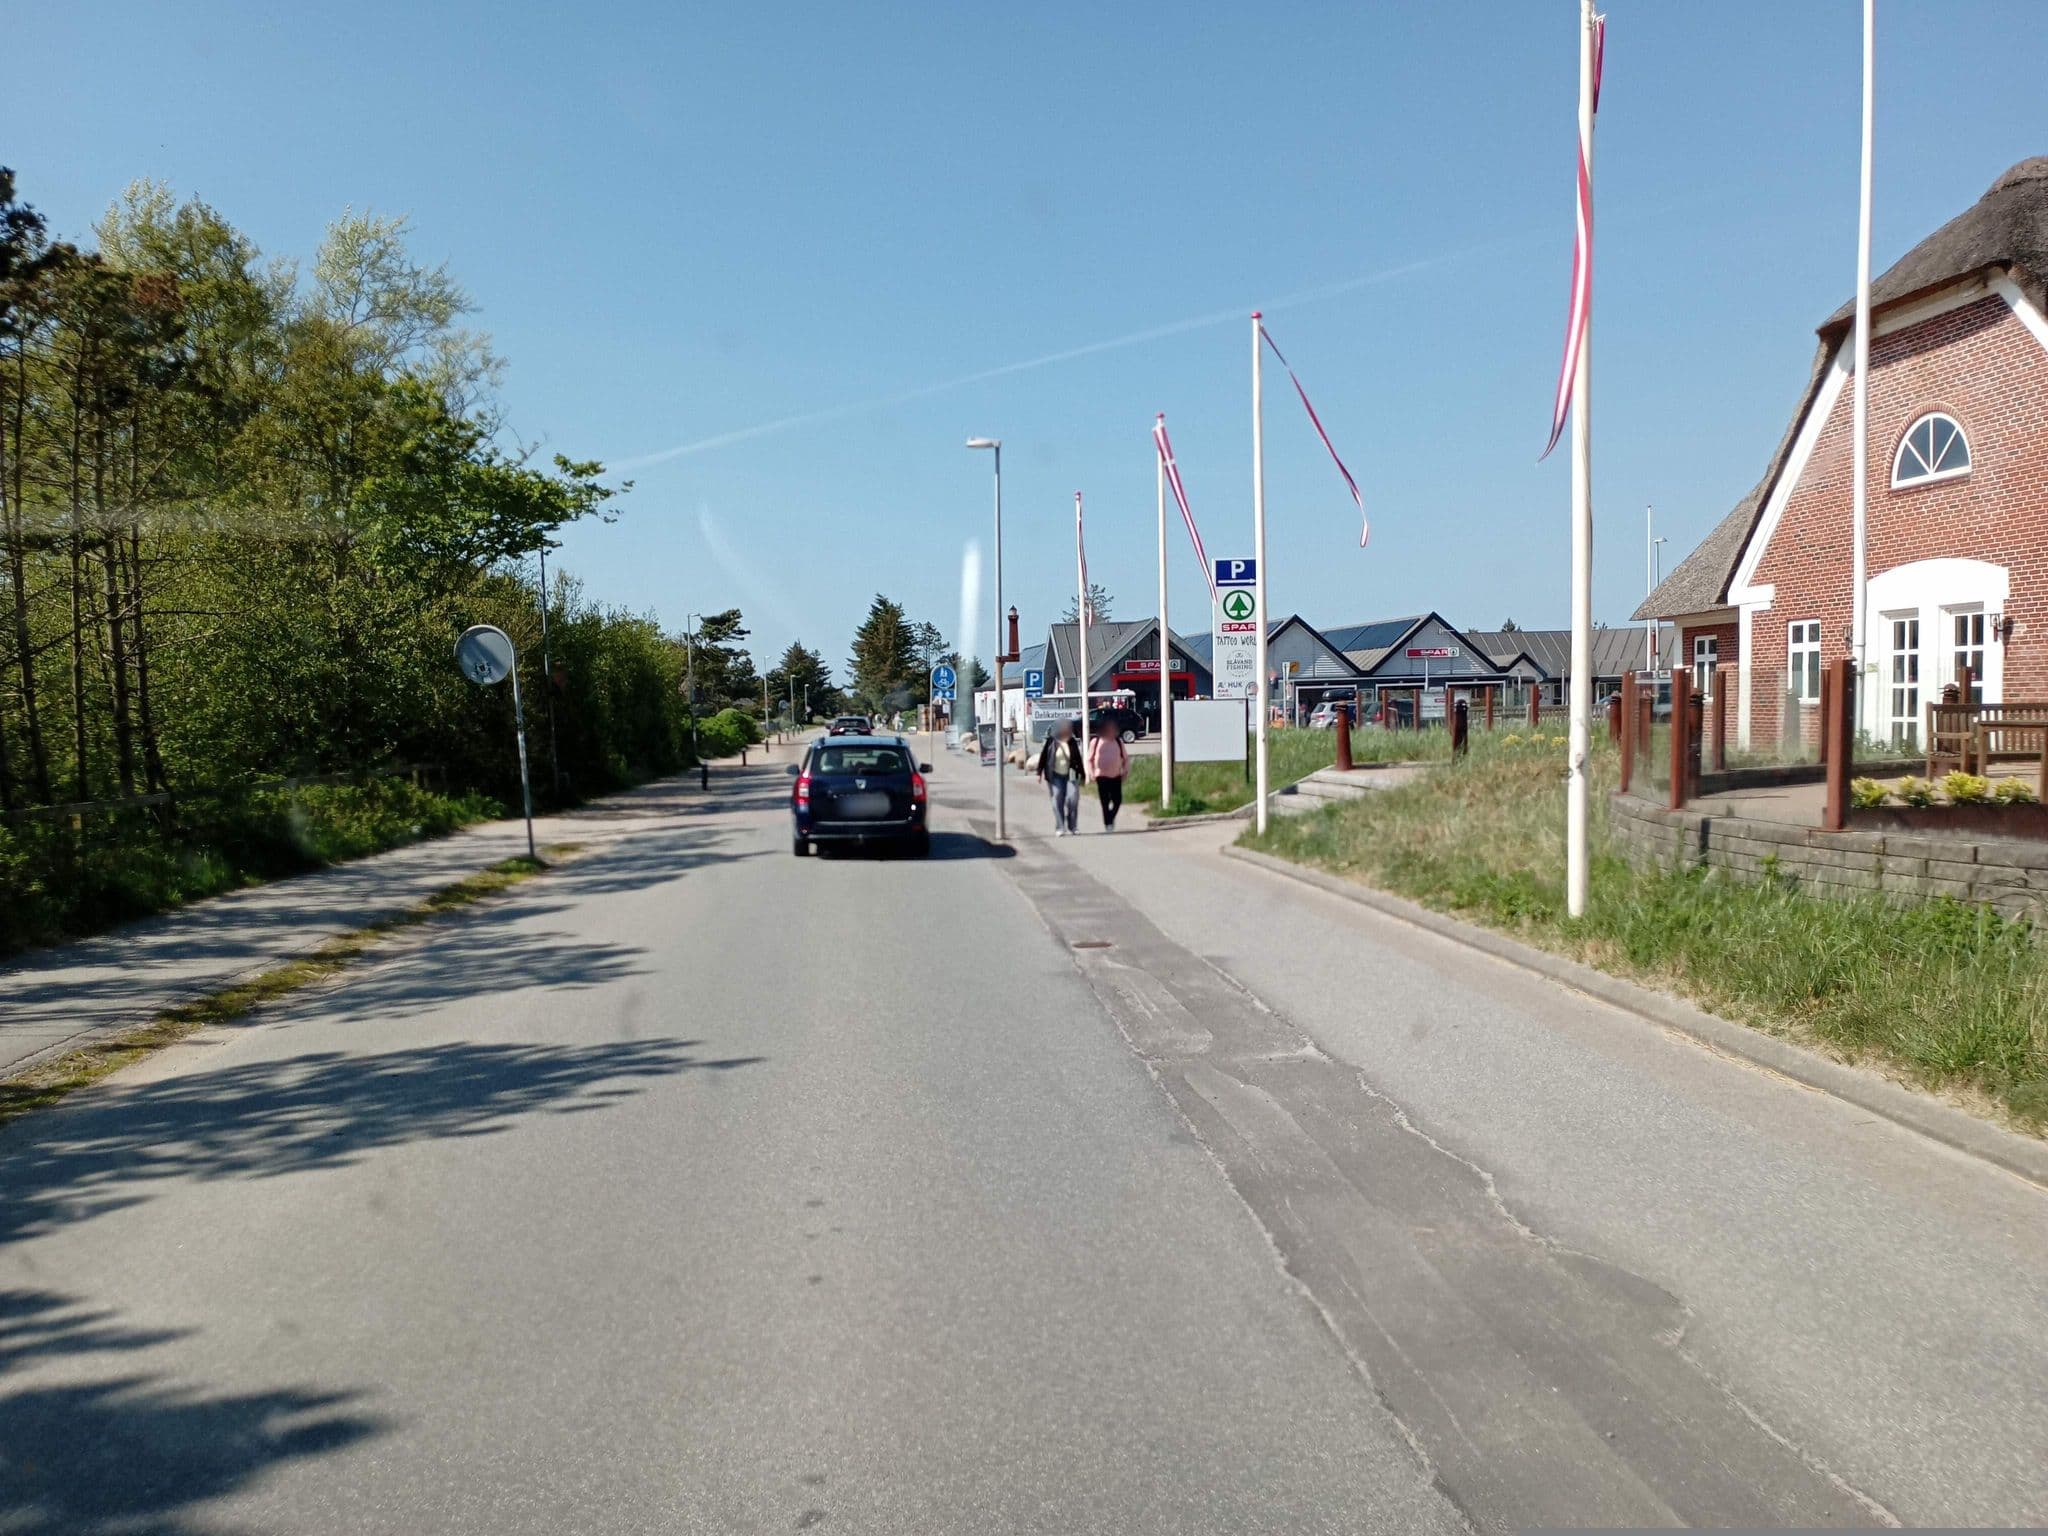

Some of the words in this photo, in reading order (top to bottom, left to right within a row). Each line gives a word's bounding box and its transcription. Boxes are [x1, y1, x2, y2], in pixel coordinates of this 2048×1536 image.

[1230, 560, 1245, 579] P
[1222, 624, 1256, 632] SPAR
[1240, 636, 1257, 647] WORL
[1029, 673, 1039, 686] P
